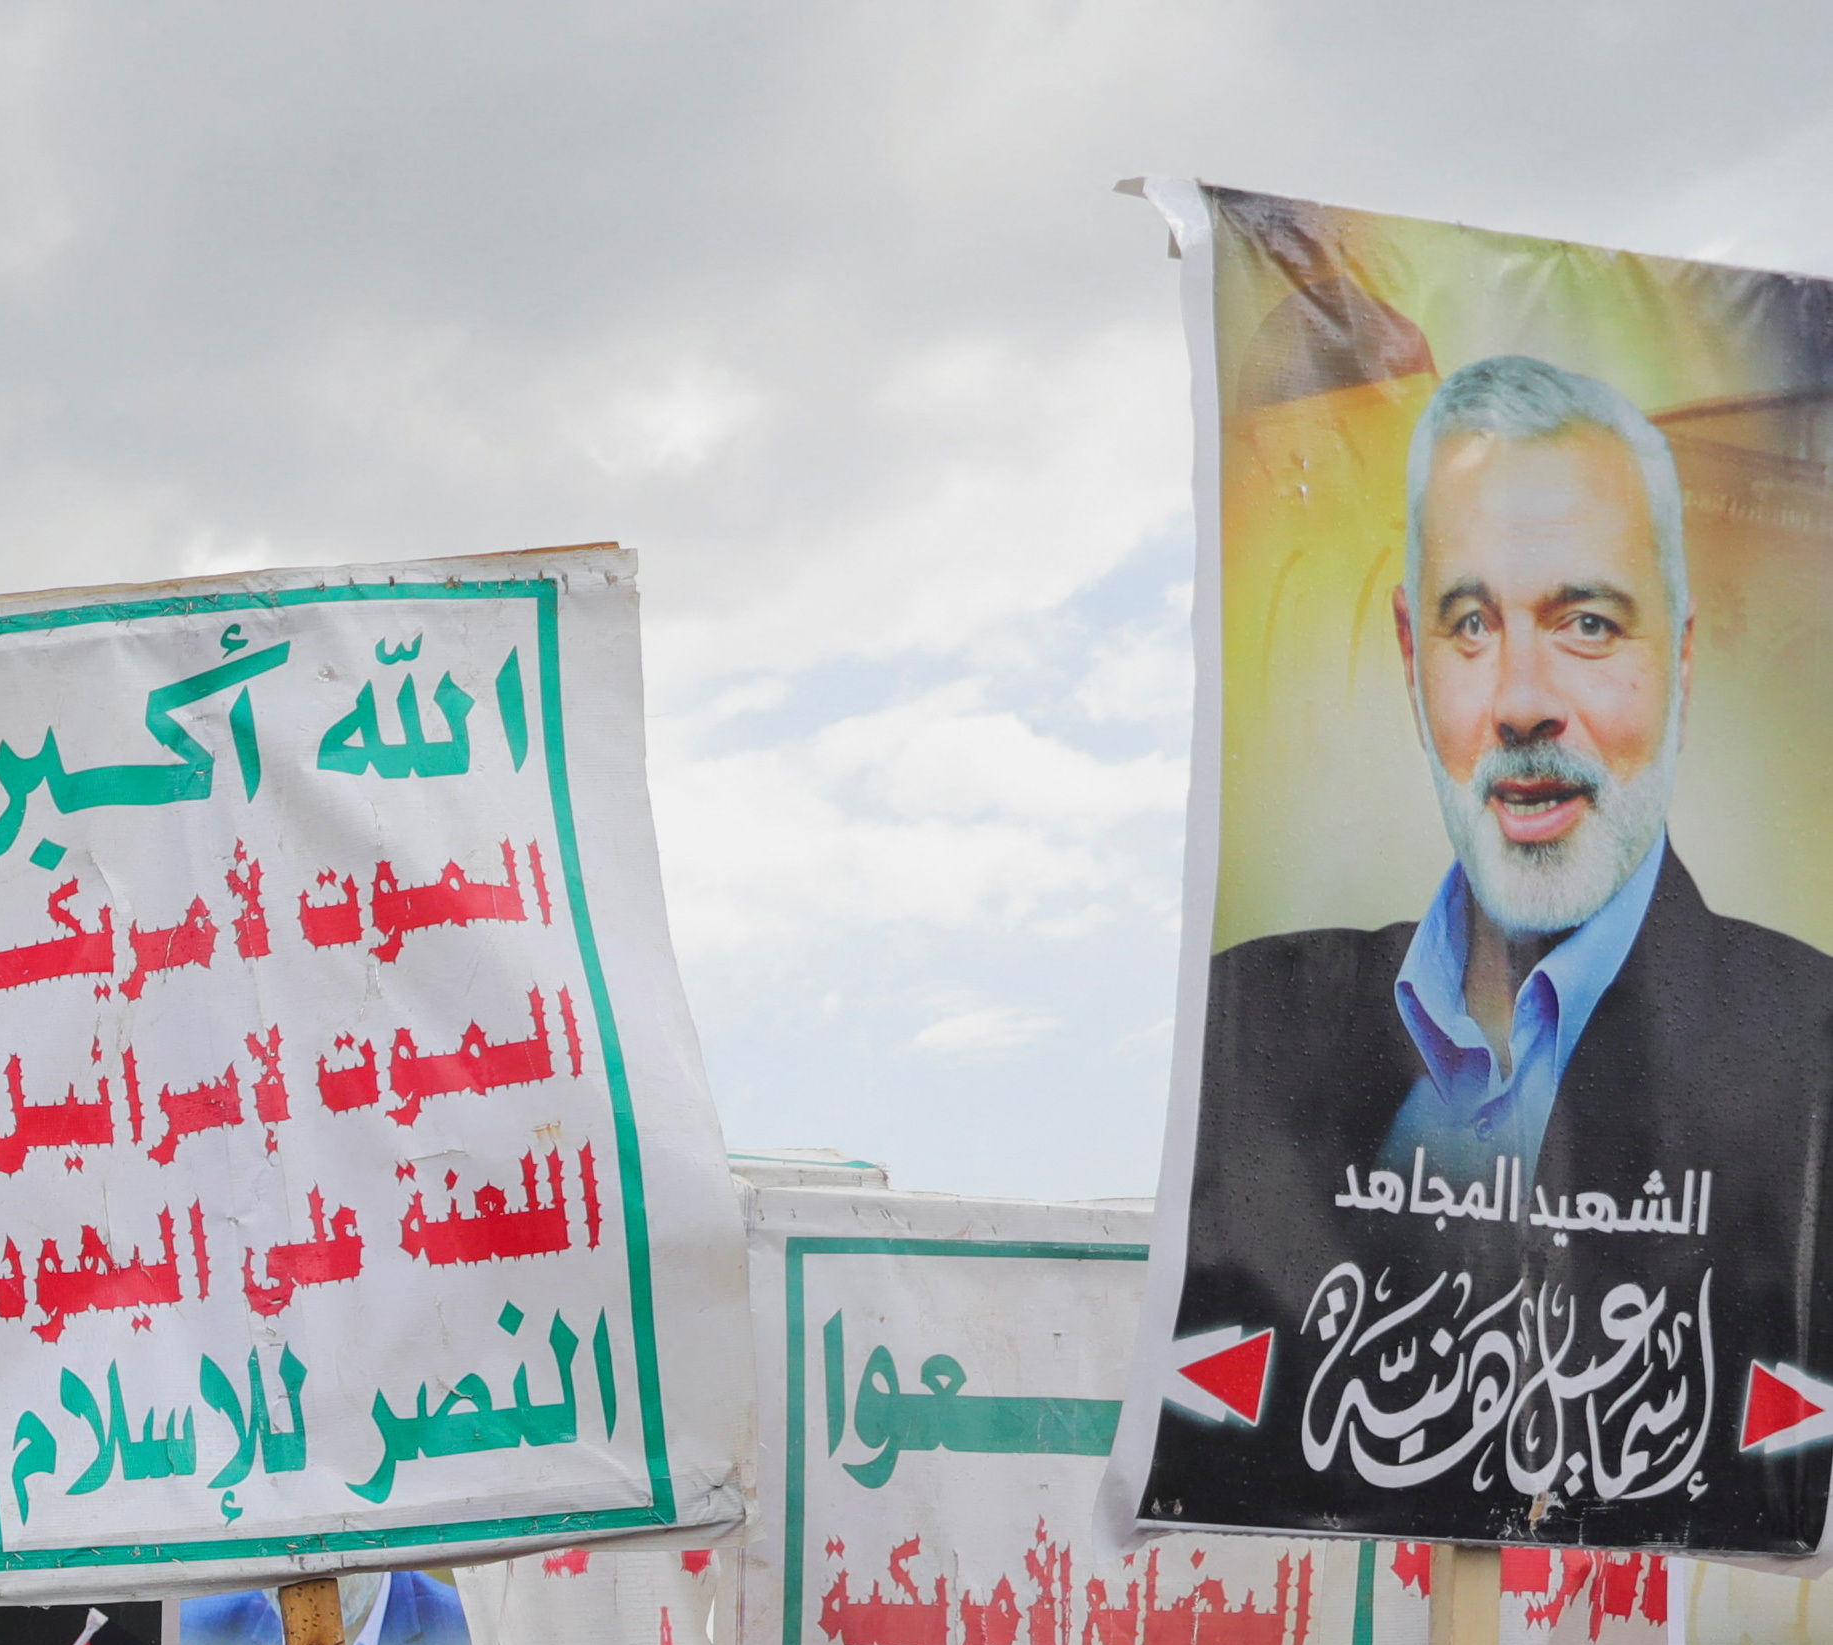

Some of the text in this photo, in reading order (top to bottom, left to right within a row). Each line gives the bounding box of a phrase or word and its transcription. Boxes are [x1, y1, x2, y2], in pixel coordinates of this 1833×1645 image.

[316, 630, 530, 779] الله
[297, 834, 553, 963] الموت
[317, 982, 584, 1127] الموت
[242, 1182, 365, 1318] على
[397, 1138, 603, 1268] اللعنة
[1335, 1147, 1711, 1247] الشهيد المجاهد
[11, 1300, 617, 1527] النصر للإسلام
[1505, 1267, 1714, 1502] إسماعيل
